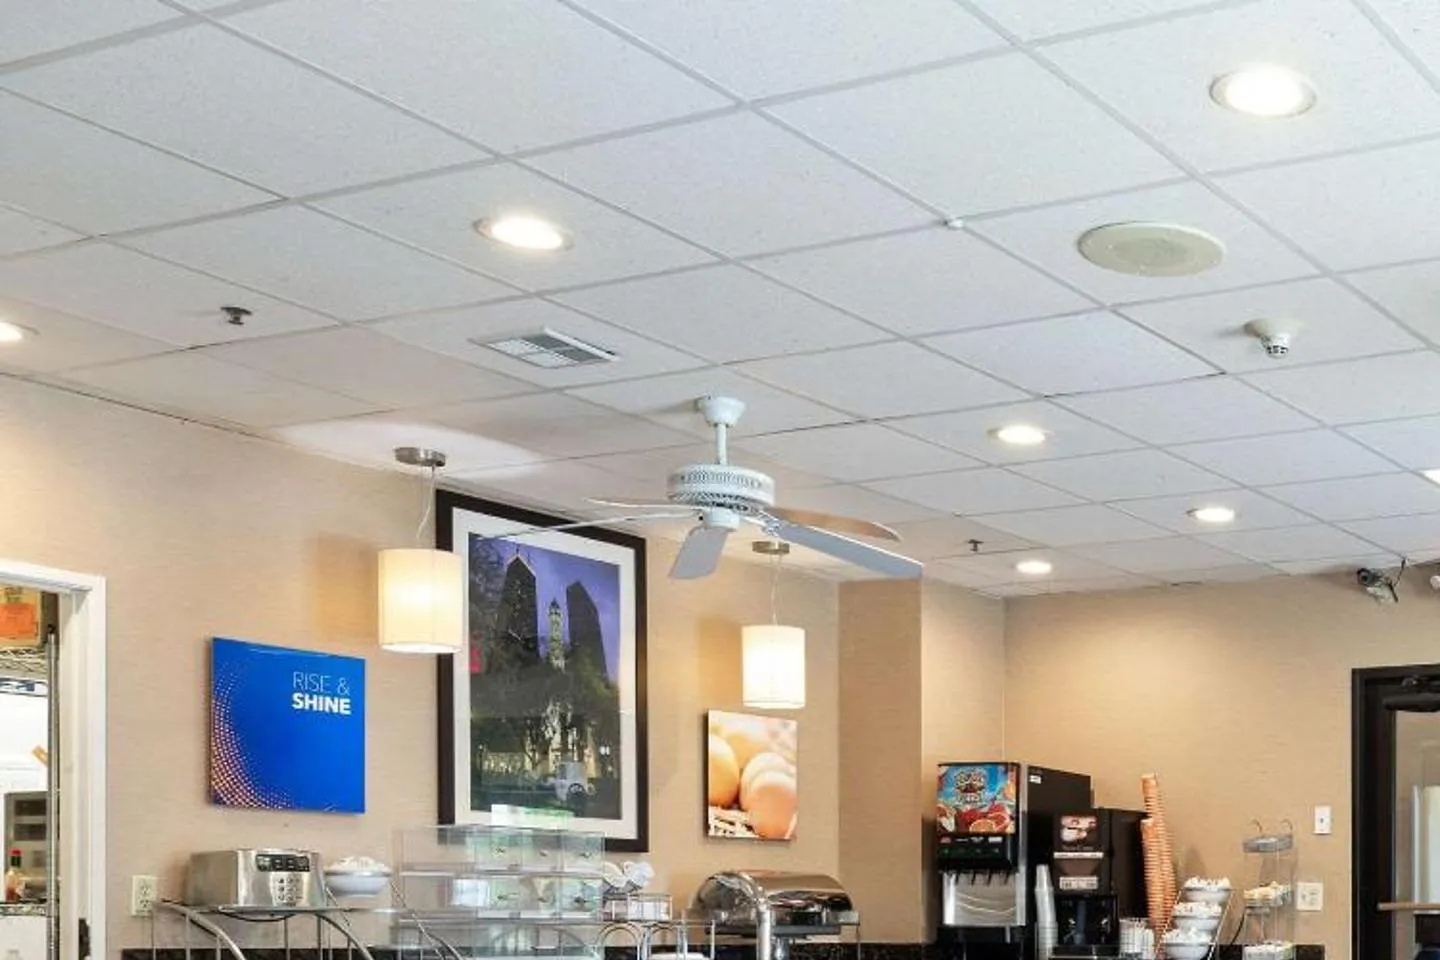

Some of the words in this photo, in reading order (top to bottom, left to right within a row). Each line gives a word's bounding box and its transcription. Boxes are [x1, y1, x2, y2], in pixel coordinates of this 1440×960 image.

[292, 671, 332, 694] RISE
[337, 677, 350, 696] &
[292, 692, 352, 715] SHINE
